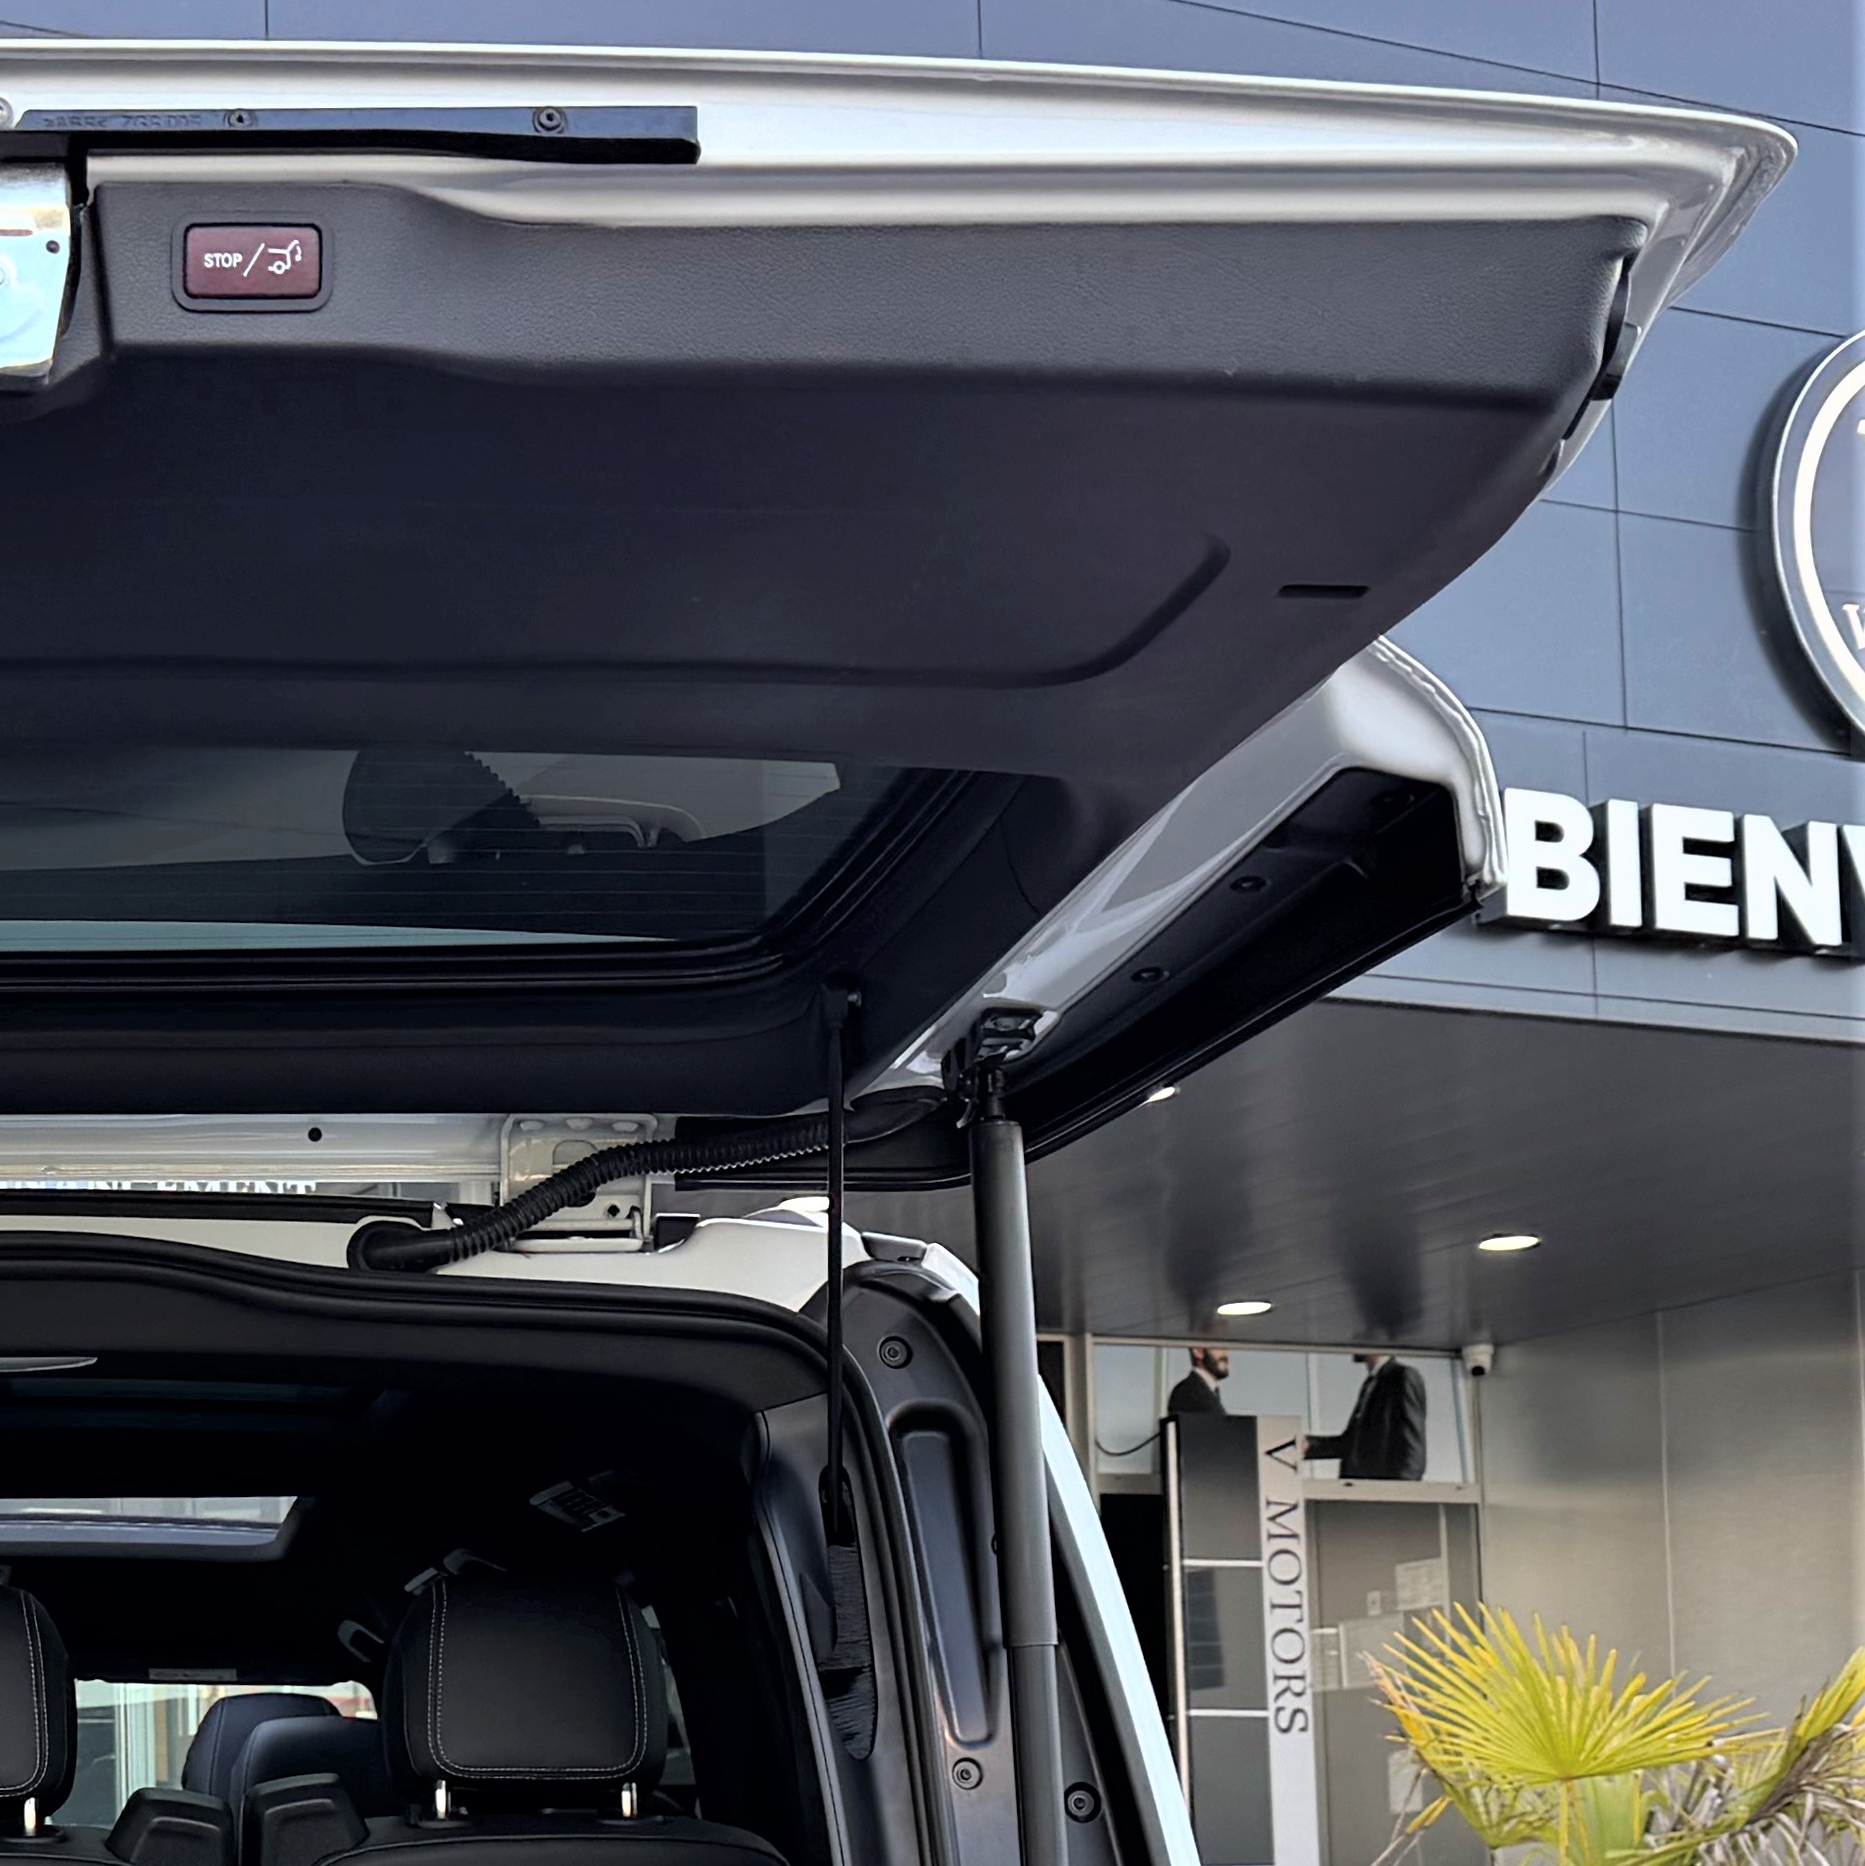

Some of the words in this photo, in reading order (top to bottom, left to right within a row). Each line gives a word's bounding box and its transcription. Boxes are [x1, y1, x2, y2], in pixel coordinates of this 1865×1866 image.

[203, 252, 243, 268] STOP
[1503, 786, 1865, 946] BIEN
[1264, 1434, 1298, 1474] V
[1265, 1497, 1309, 1733] MOTORS
